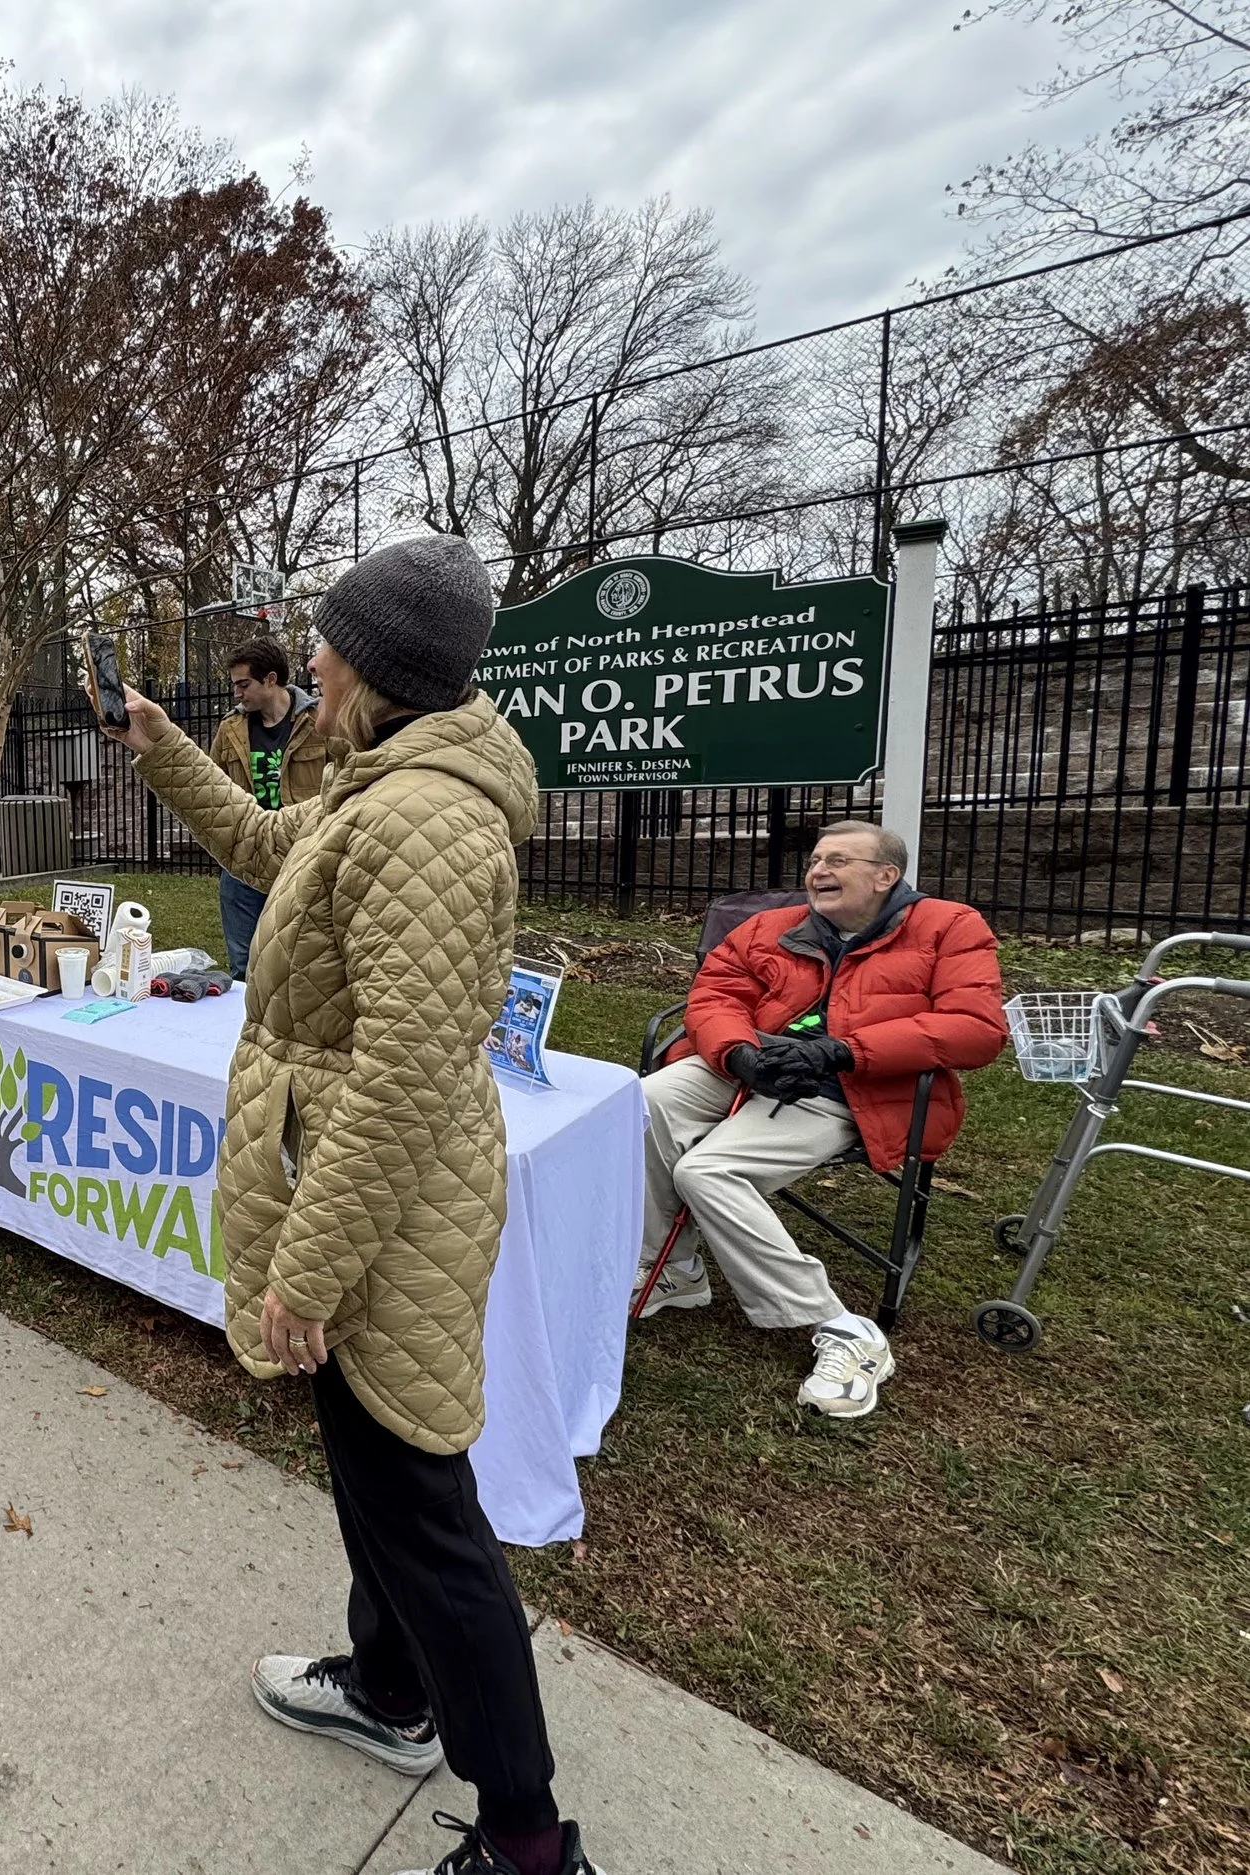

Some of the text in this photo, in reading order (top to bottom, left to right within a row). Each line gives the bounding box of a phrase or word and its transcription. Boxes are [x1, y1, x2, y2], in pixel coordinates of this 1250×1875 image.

[469, 629, 856, 683] ARTMENT OF PARKS & RECREATION
[480, 644, 526, 659] own
[534, 636, 560, 653] of
[567, 628, 641, 650] North
[652, 606, 816, 640] Hempstead
[581, 679, 635, 714] O.
[654, 657, 865, 709] PETRUS
[560, 714, 686, 754] PARK
[567, 761, 623, 775] JENNIFER
[627, 760, 638, 771] S.
[578, 771, 678, 784] TOWN SUPERVISOR
[26, 1060, 226, 1177] RESID
